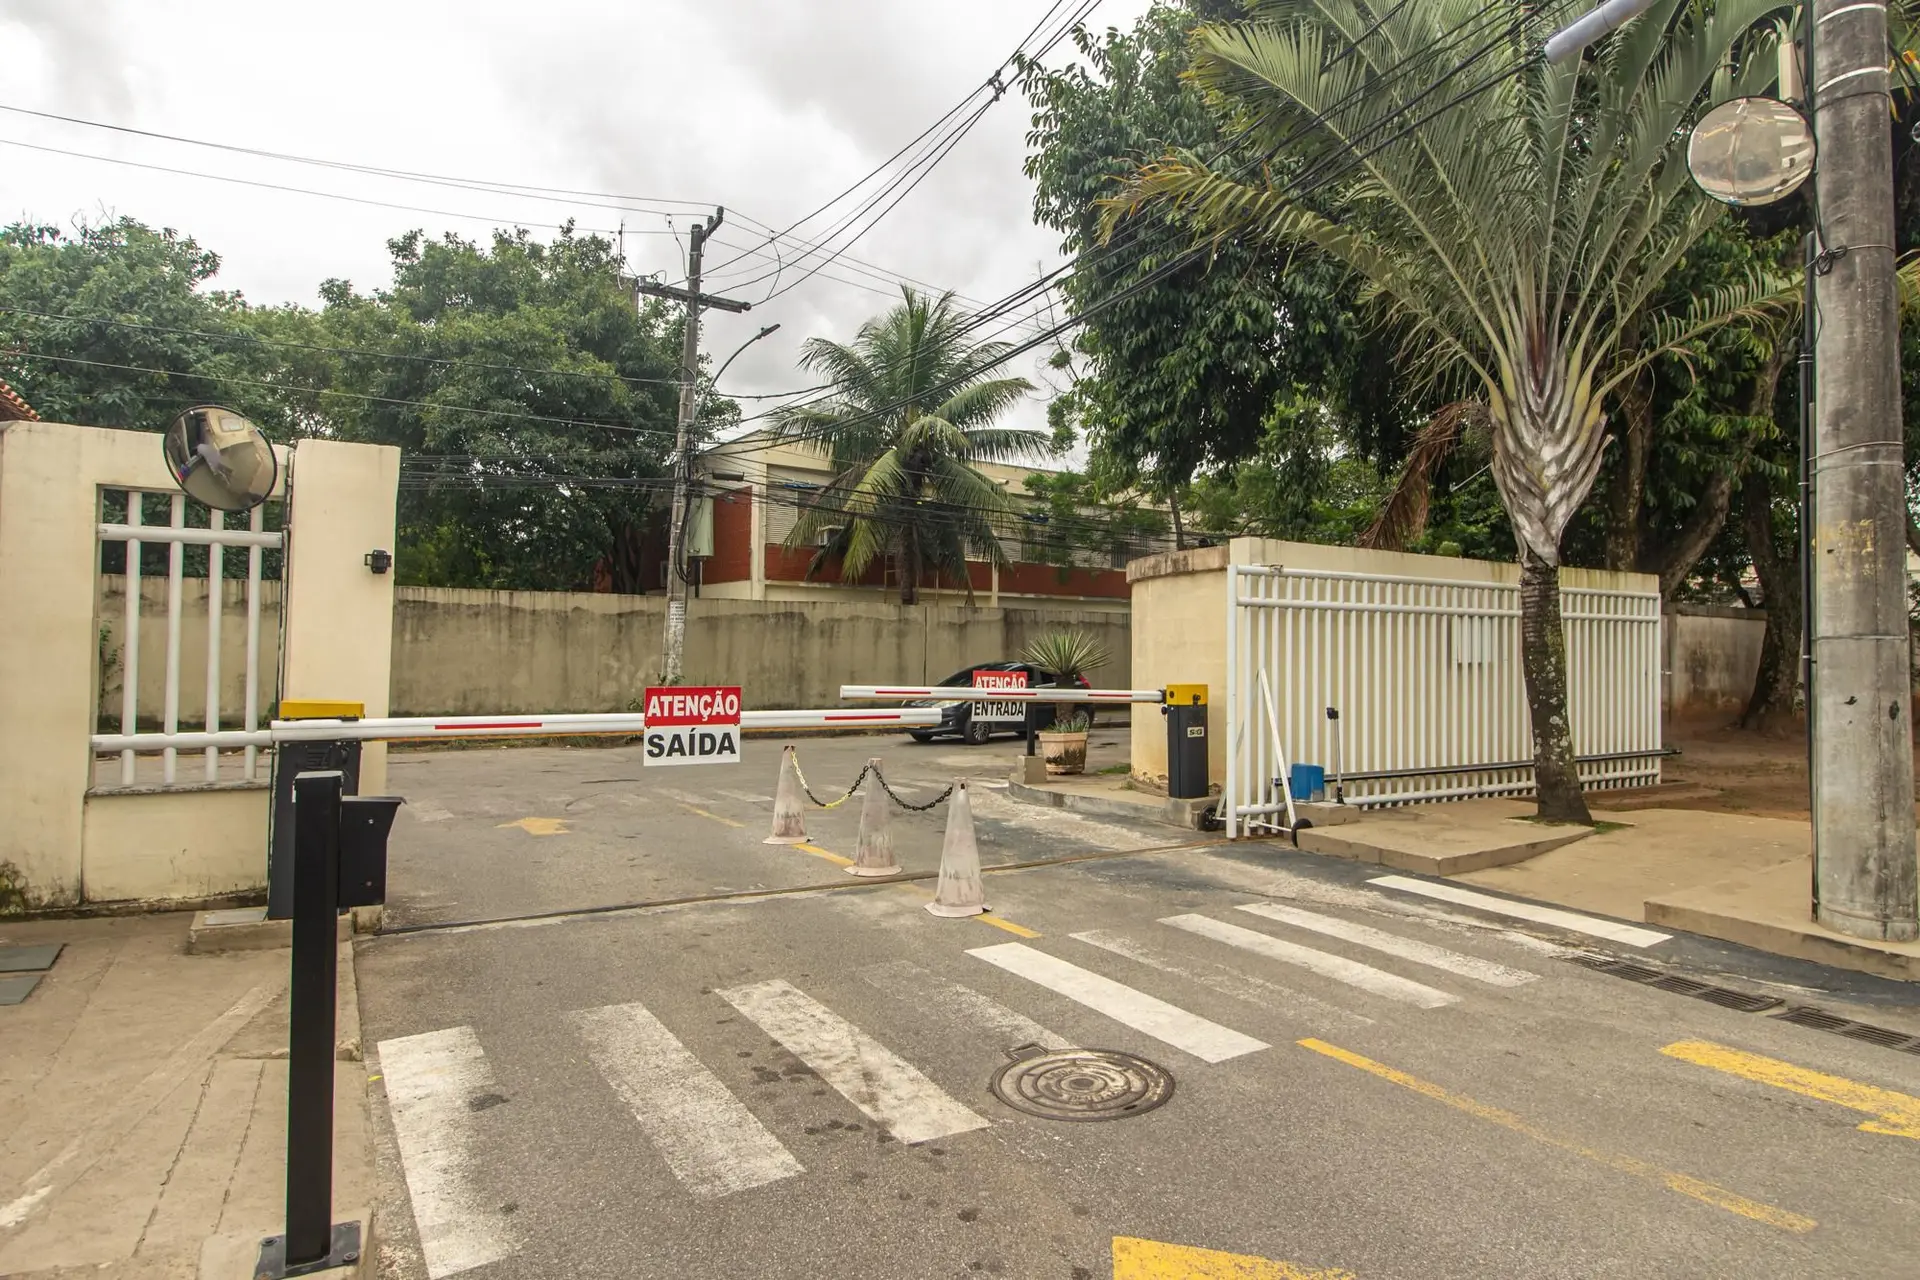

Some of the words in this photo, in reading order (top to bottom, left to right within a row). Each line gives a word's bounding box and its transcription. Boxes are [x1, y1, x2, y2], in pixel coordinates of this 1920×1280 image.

[647, 690, 739, 721] ATENÇÃO
[973, 701, 1024, 716] ENTRADA
[646, 727, 737, 758] SAÍDA
